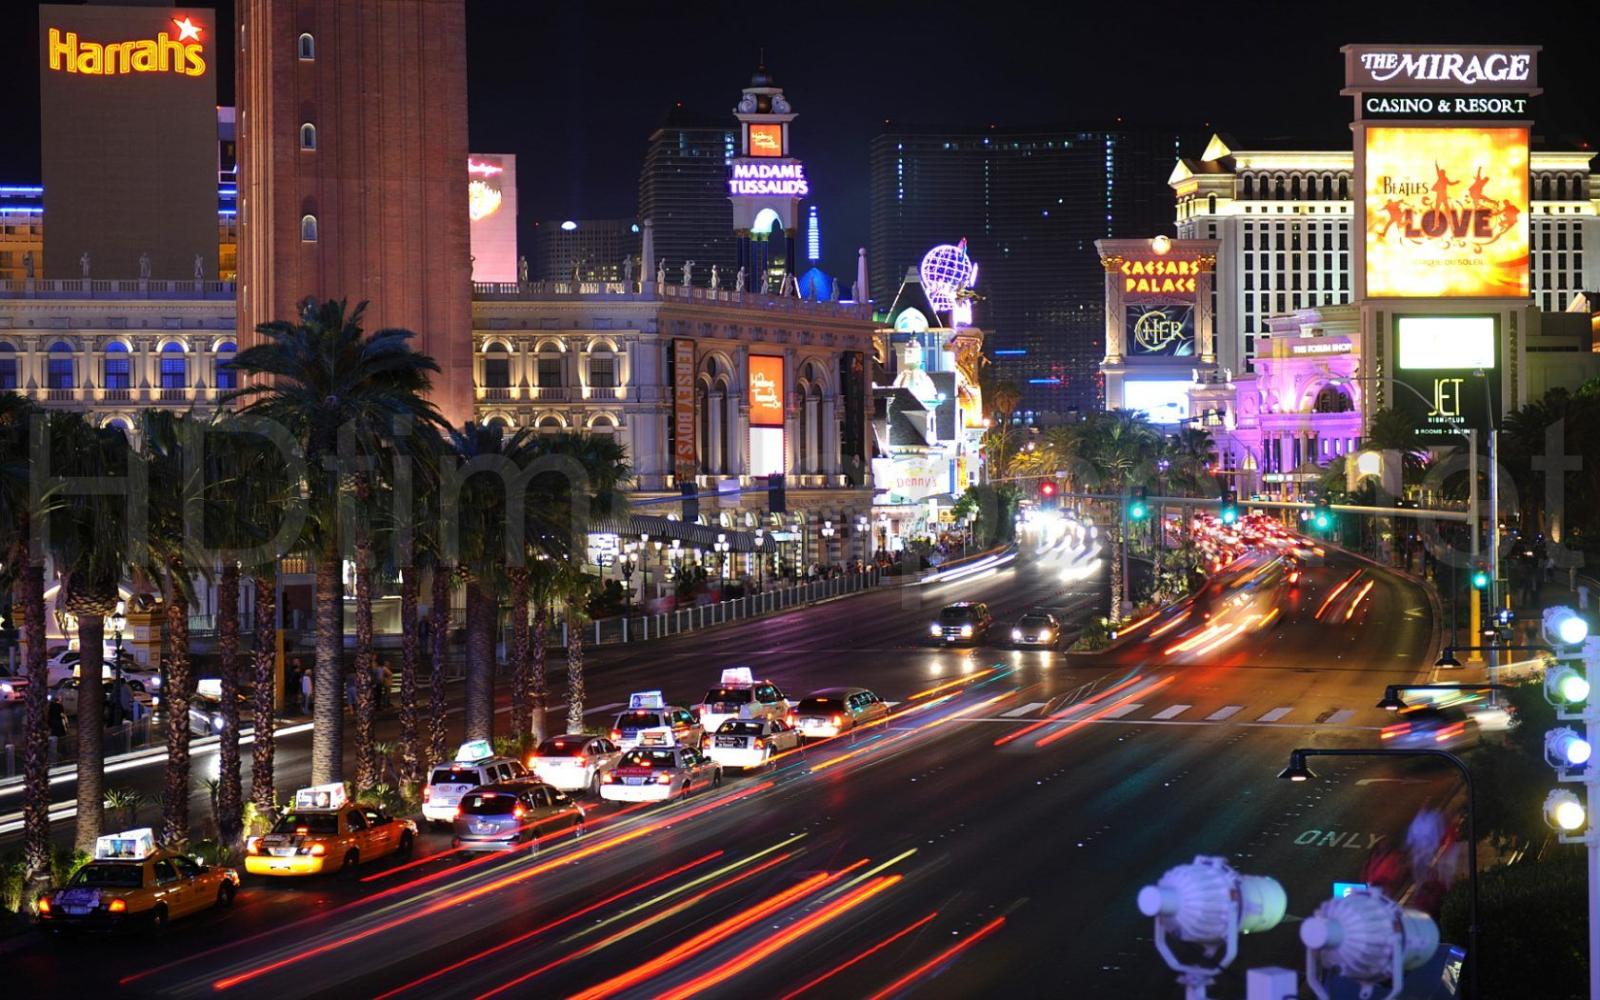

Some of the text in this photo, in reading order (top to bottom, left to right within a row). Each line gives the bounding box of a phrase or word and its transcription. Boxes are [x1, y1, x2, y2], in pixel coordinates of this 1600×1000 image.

[1361, 53, 1531, 85] THE MIRAGE
[1366, 98, 1527, 113] CASINO & RESORT
[734, 164, 804, 178] MADAME
[728, 179, 809, 195] TUSSAUD'S
[1404, 208, 1493, 238] LOVE
[1121, 260, 1199, 276] CAESARS
[1126, 278, 1196, 293] PALACE
[1134, 310, 1186, 352] CHER
[676, 341, 693, 455] JERSEY BOYS
[1427, 378, 1464, 417] JET
[1293, 829, 1386, 849] ONLY
